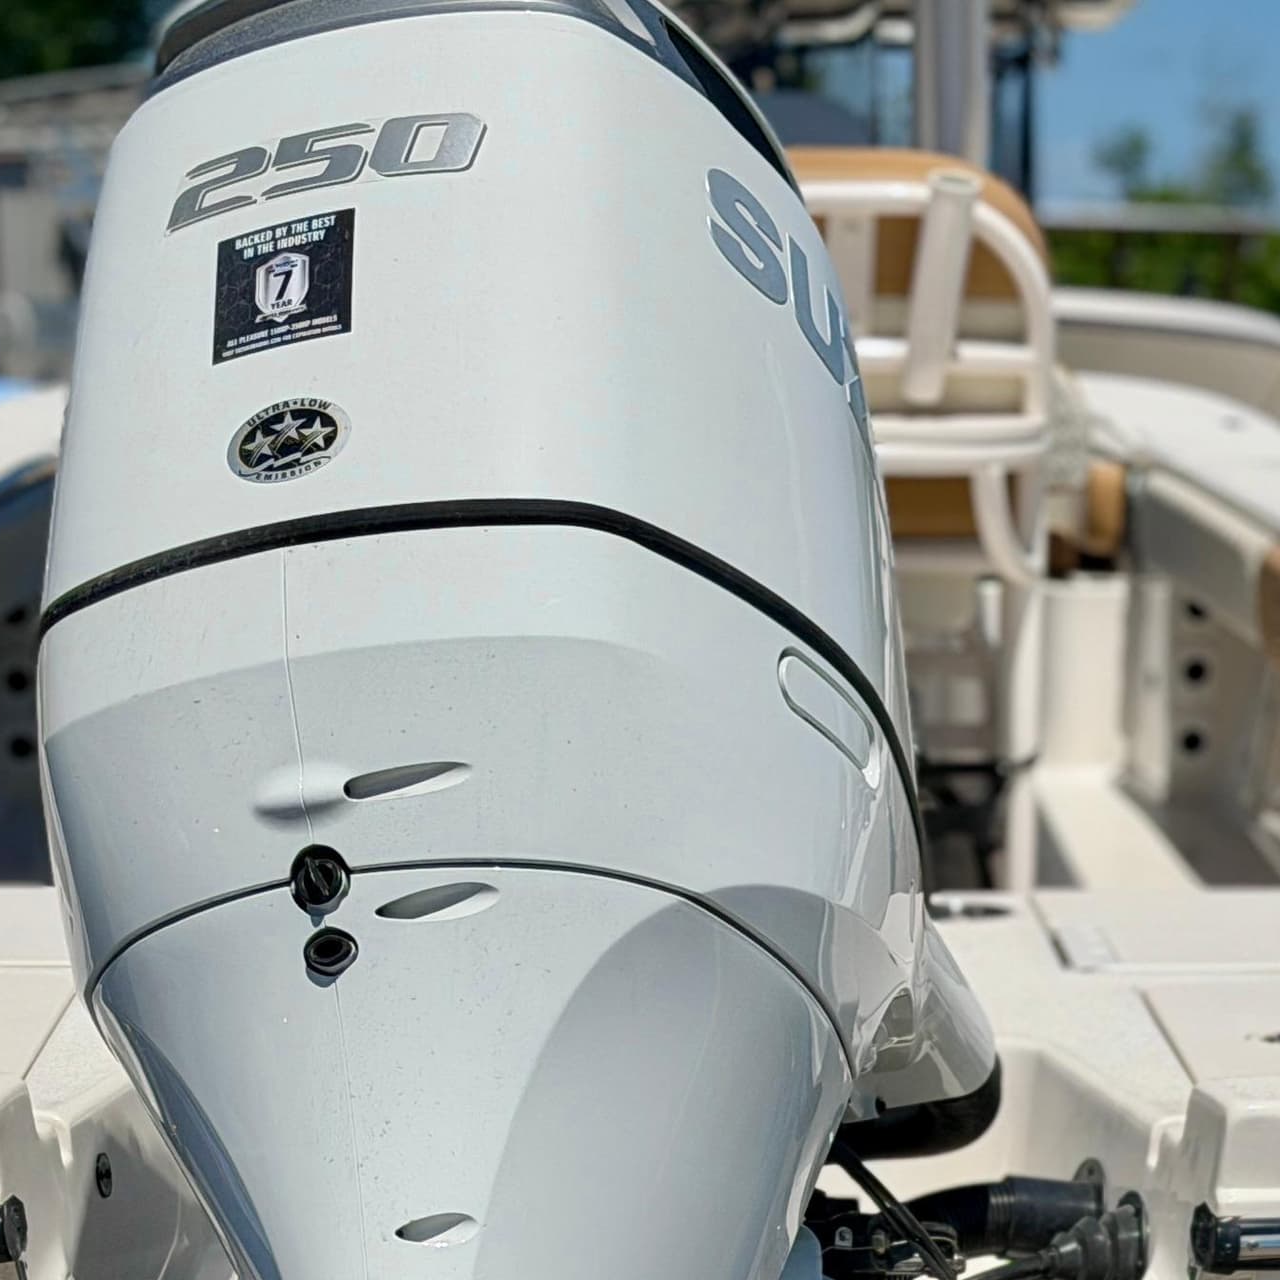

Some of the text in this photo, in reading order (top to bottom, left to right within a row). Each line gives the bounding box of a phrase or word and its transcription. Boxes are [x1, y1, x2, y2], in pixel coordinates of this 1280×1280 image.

[166, 112, 487, 234] 250
[235, 215, 337, 250] BACKED BY THE BEST
[243, 229, 327, 260] IN THE INDUSTRY
[273, 269, 293, 301] 7
[271, 299, 293, 310] YEAR
[245, 399, 332, 427] ULTRA LOW
[255, 460, 322, 481] EMISSION
